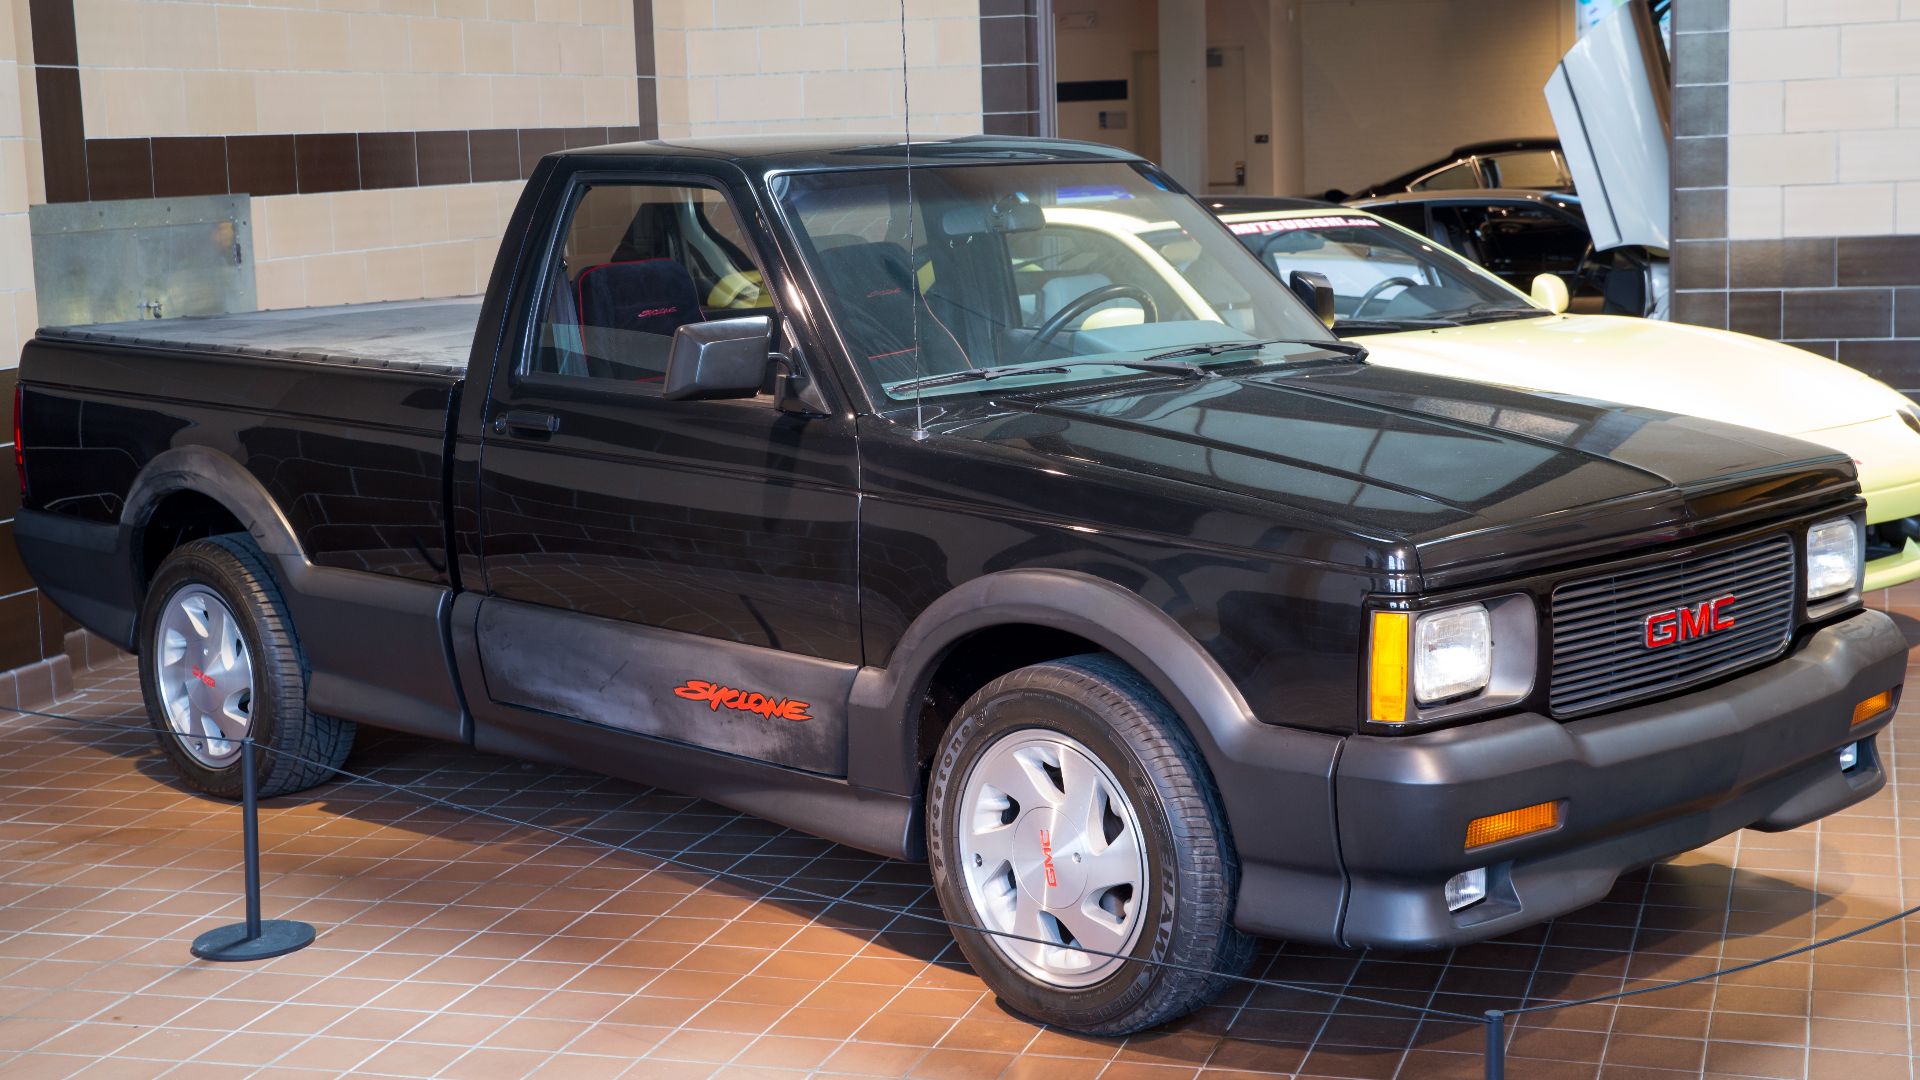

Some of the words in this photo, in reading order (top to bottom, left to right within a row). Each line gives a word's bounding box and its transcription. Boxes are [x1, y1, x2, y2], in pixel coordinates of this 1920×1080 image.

[1646, 594, 1736, 648] GMC
[673, 679, 815, 721] SYCLONE
[1040, 829, 1057, 887] GMC
